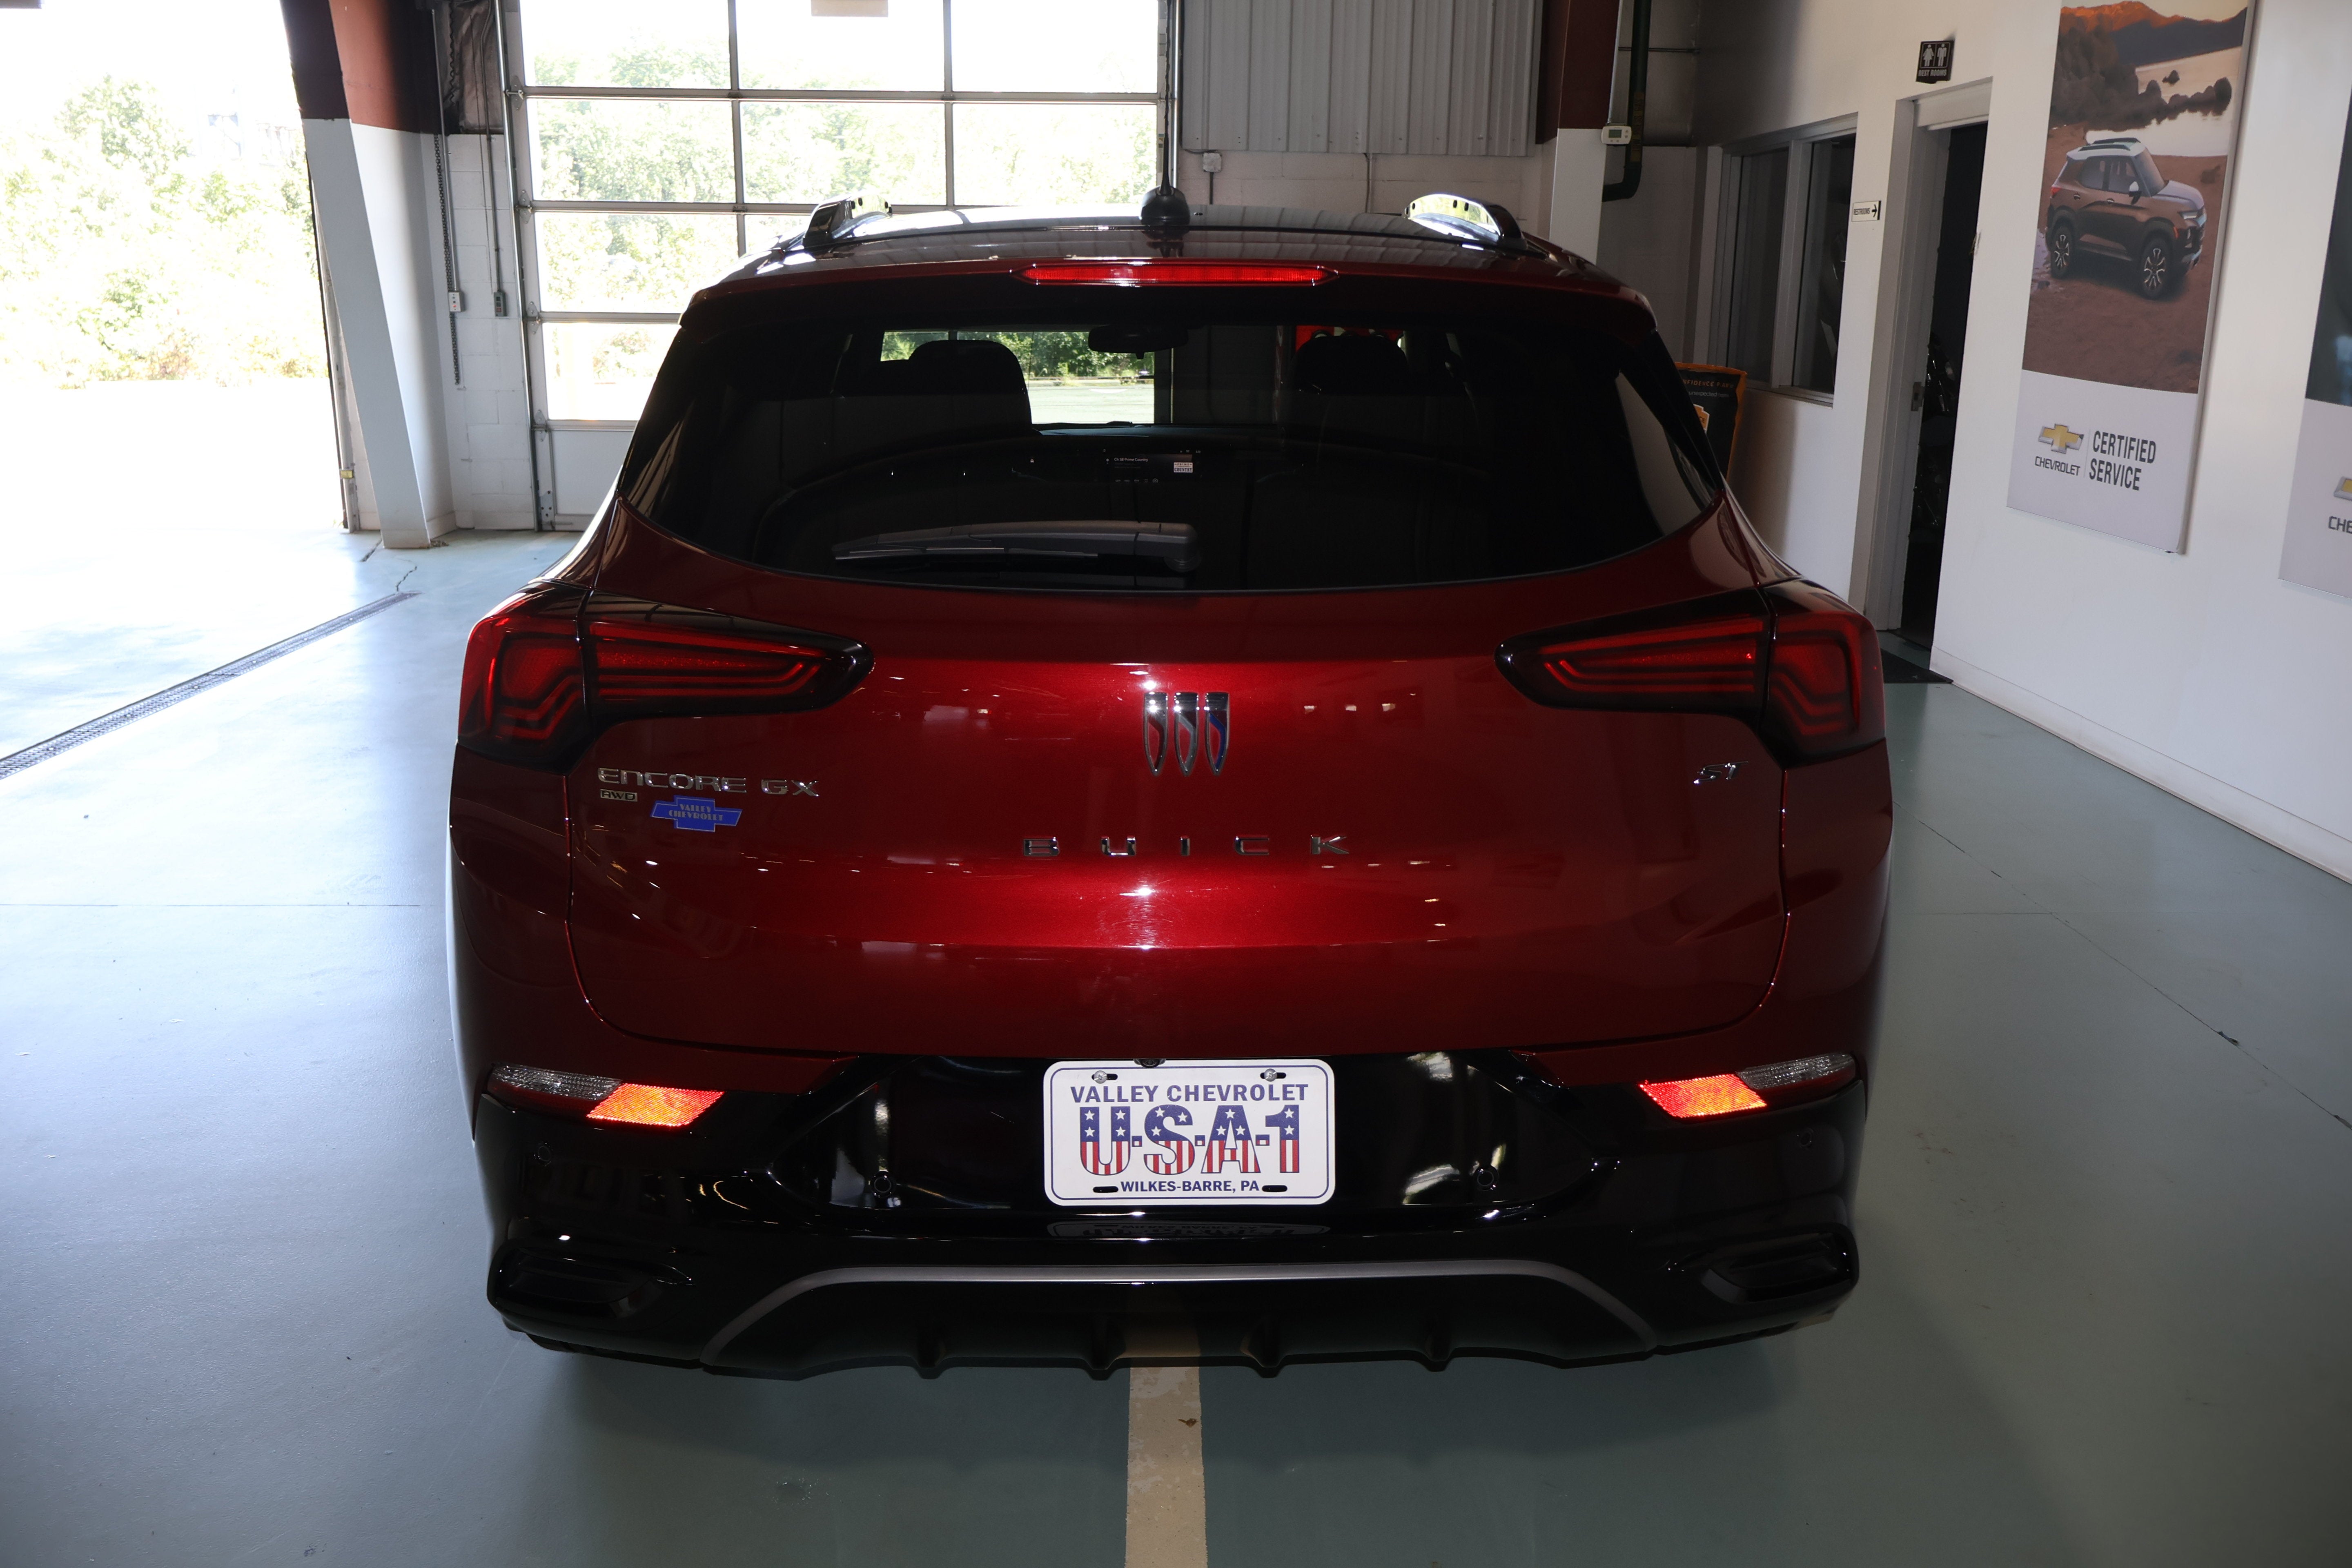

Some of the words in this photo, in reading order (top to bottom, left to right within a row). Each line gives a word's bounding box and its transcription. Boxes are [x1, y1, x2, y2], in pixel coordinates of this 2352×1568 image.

[2092, 430, 2156, 464] CERTIFIED
[2035, 456, 2080, 476] CHEVROLET
[2089, 458, 2142, 491] SERVICE
[598, 767, 746, 793] ENCORE
[761, 779, 819, 797] GX
[1693, 761, 1748, 784] ST
[601, 790, 635, 801] AWD
[668, 810, 723, 821] CHEVROLET
[679, 804, 711, 813] VALLEY
[1023, 835, 1350, 857] BUICK
[1070, 1085, 1159, 1103] VALLEY
[1166, 1084, 1308, 1102] CHEVROLET
[1121, 1180, 1236, 1193] WILKES-BARRE,
[1241, 1180, 1259, 1192] PA
